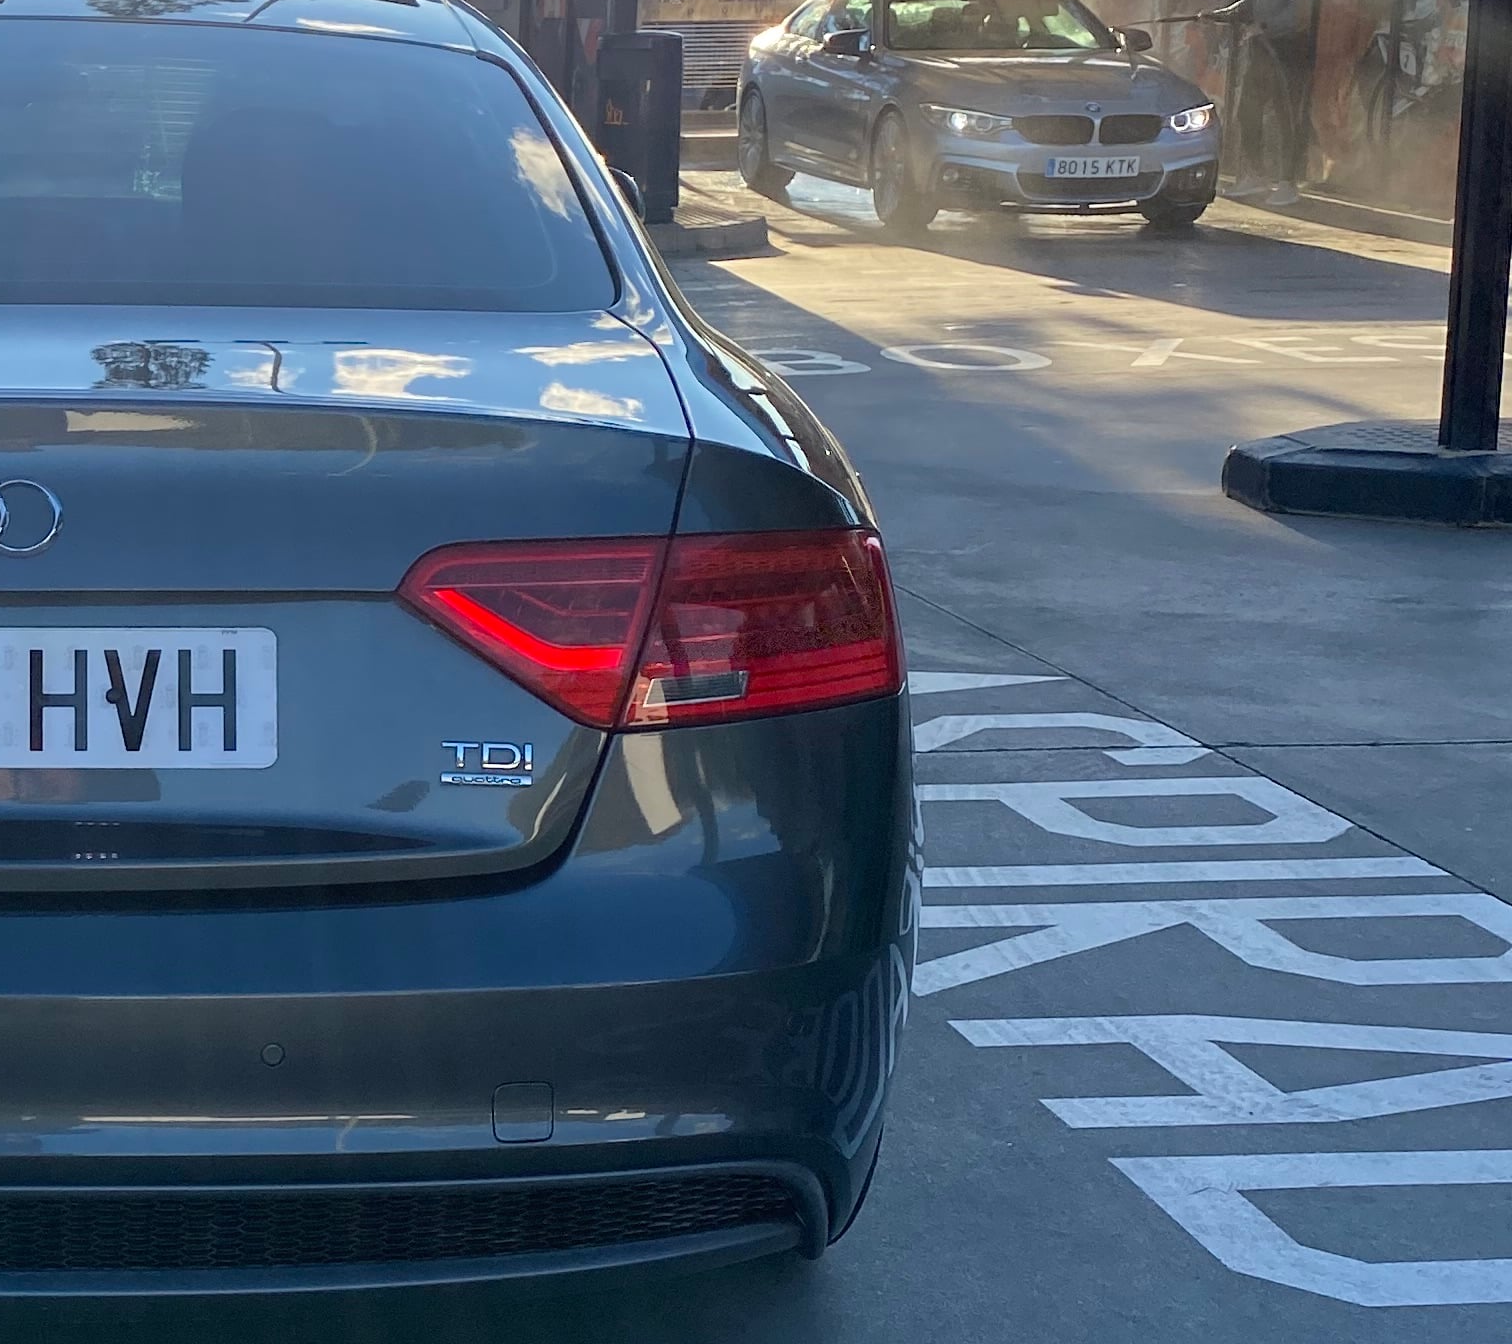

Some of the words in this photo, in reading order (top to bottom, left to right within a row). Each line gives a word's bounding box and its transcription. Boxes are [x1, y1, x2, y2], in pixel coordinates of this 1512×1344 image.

[1057, 159, 1100, 175] 8015
[1105, 158, 1137, 175] KTK
[29, 649, 238, 752] HVH
[441, 741, 533, 771] TDI
[451, 775, 522, 785] quattro
